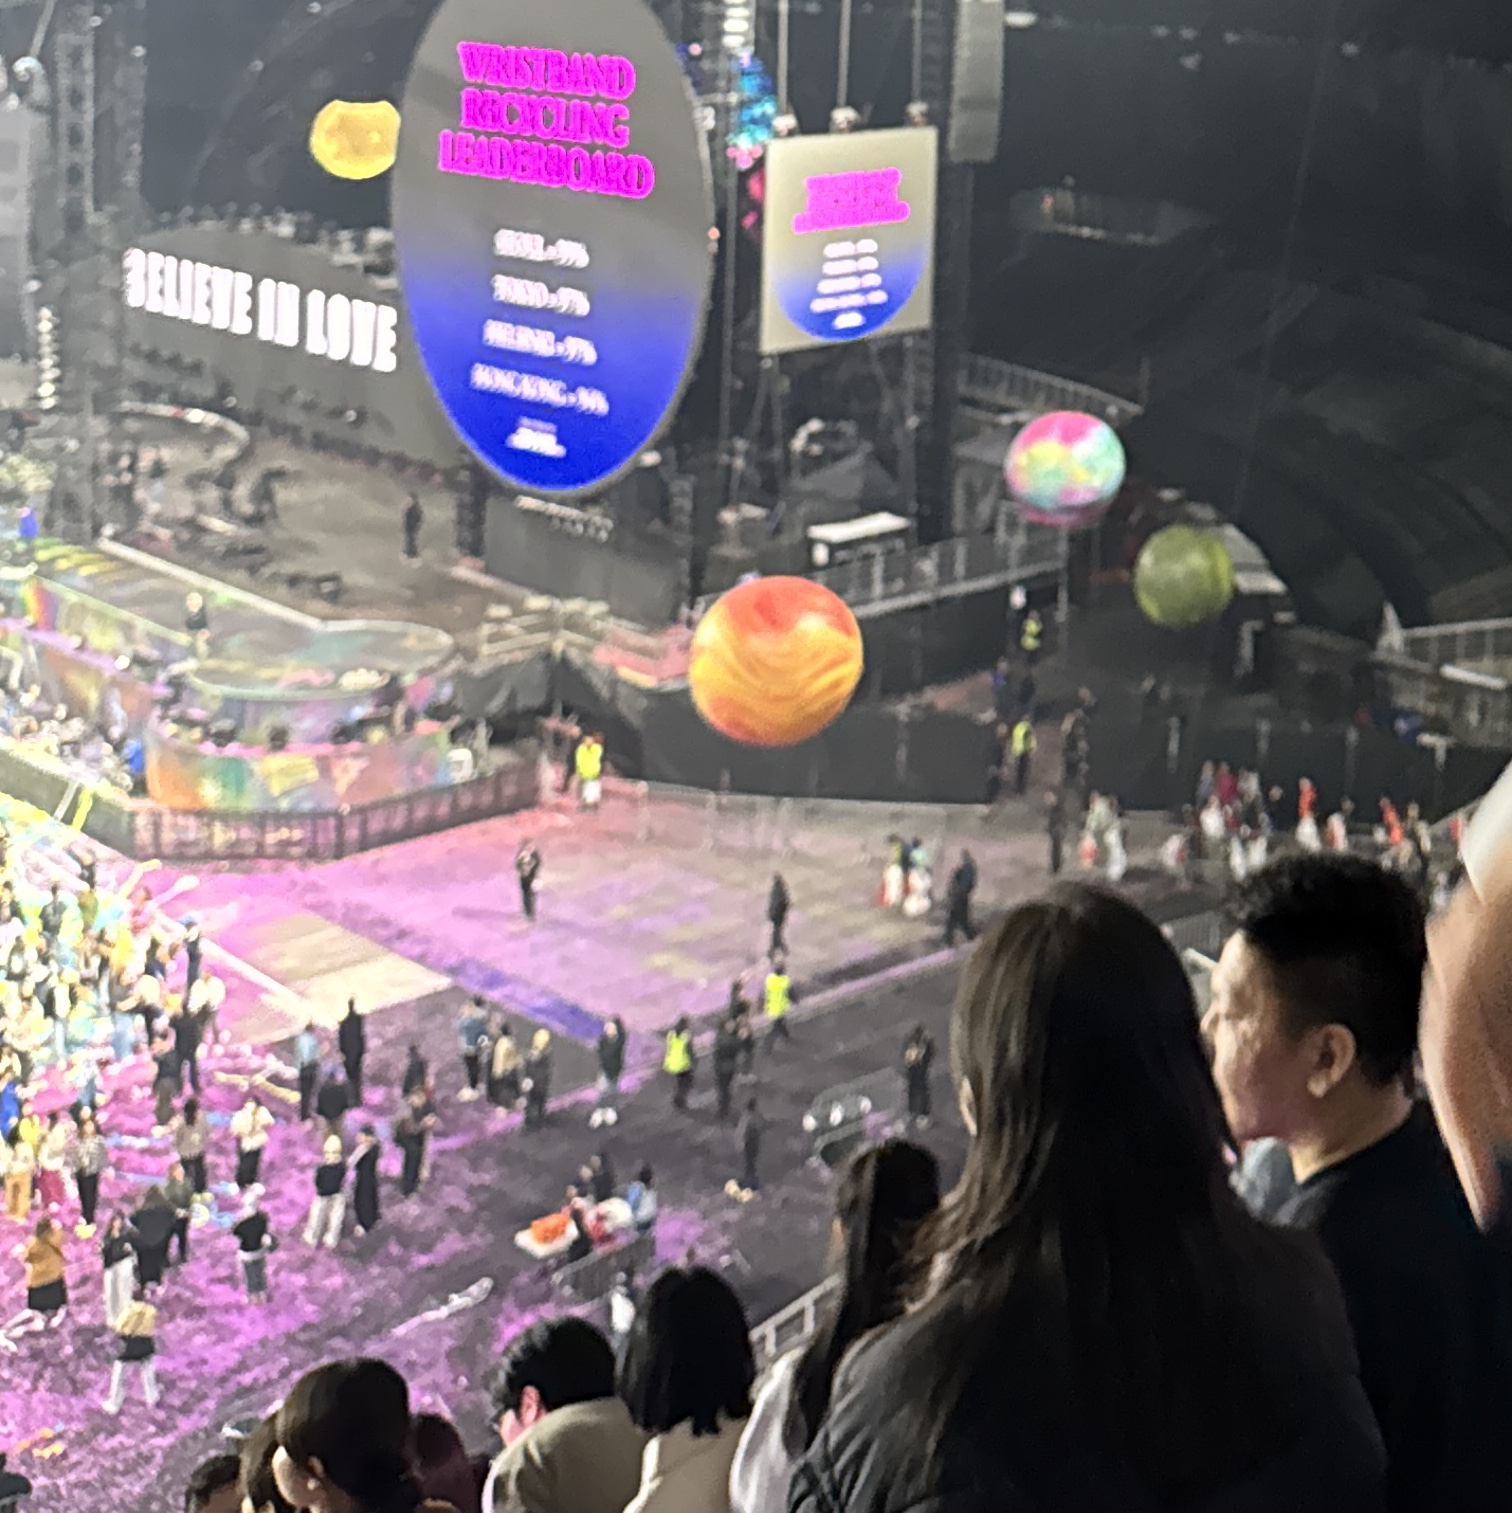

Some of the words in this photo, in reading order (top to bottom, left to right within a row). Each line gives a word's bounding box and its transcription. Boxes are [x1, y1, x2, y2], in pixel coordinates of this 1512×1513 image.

[457, 41, 637, 100] WRISTBAND
[461, 88, 630, 148] RECYCLING
[438, 130, 656, 199] LEADERBOARD
[122, 247, 252, 335] BELIEVE
[258, 278, 300, 346] IN
[306, 288, 398, 373] LOVE
